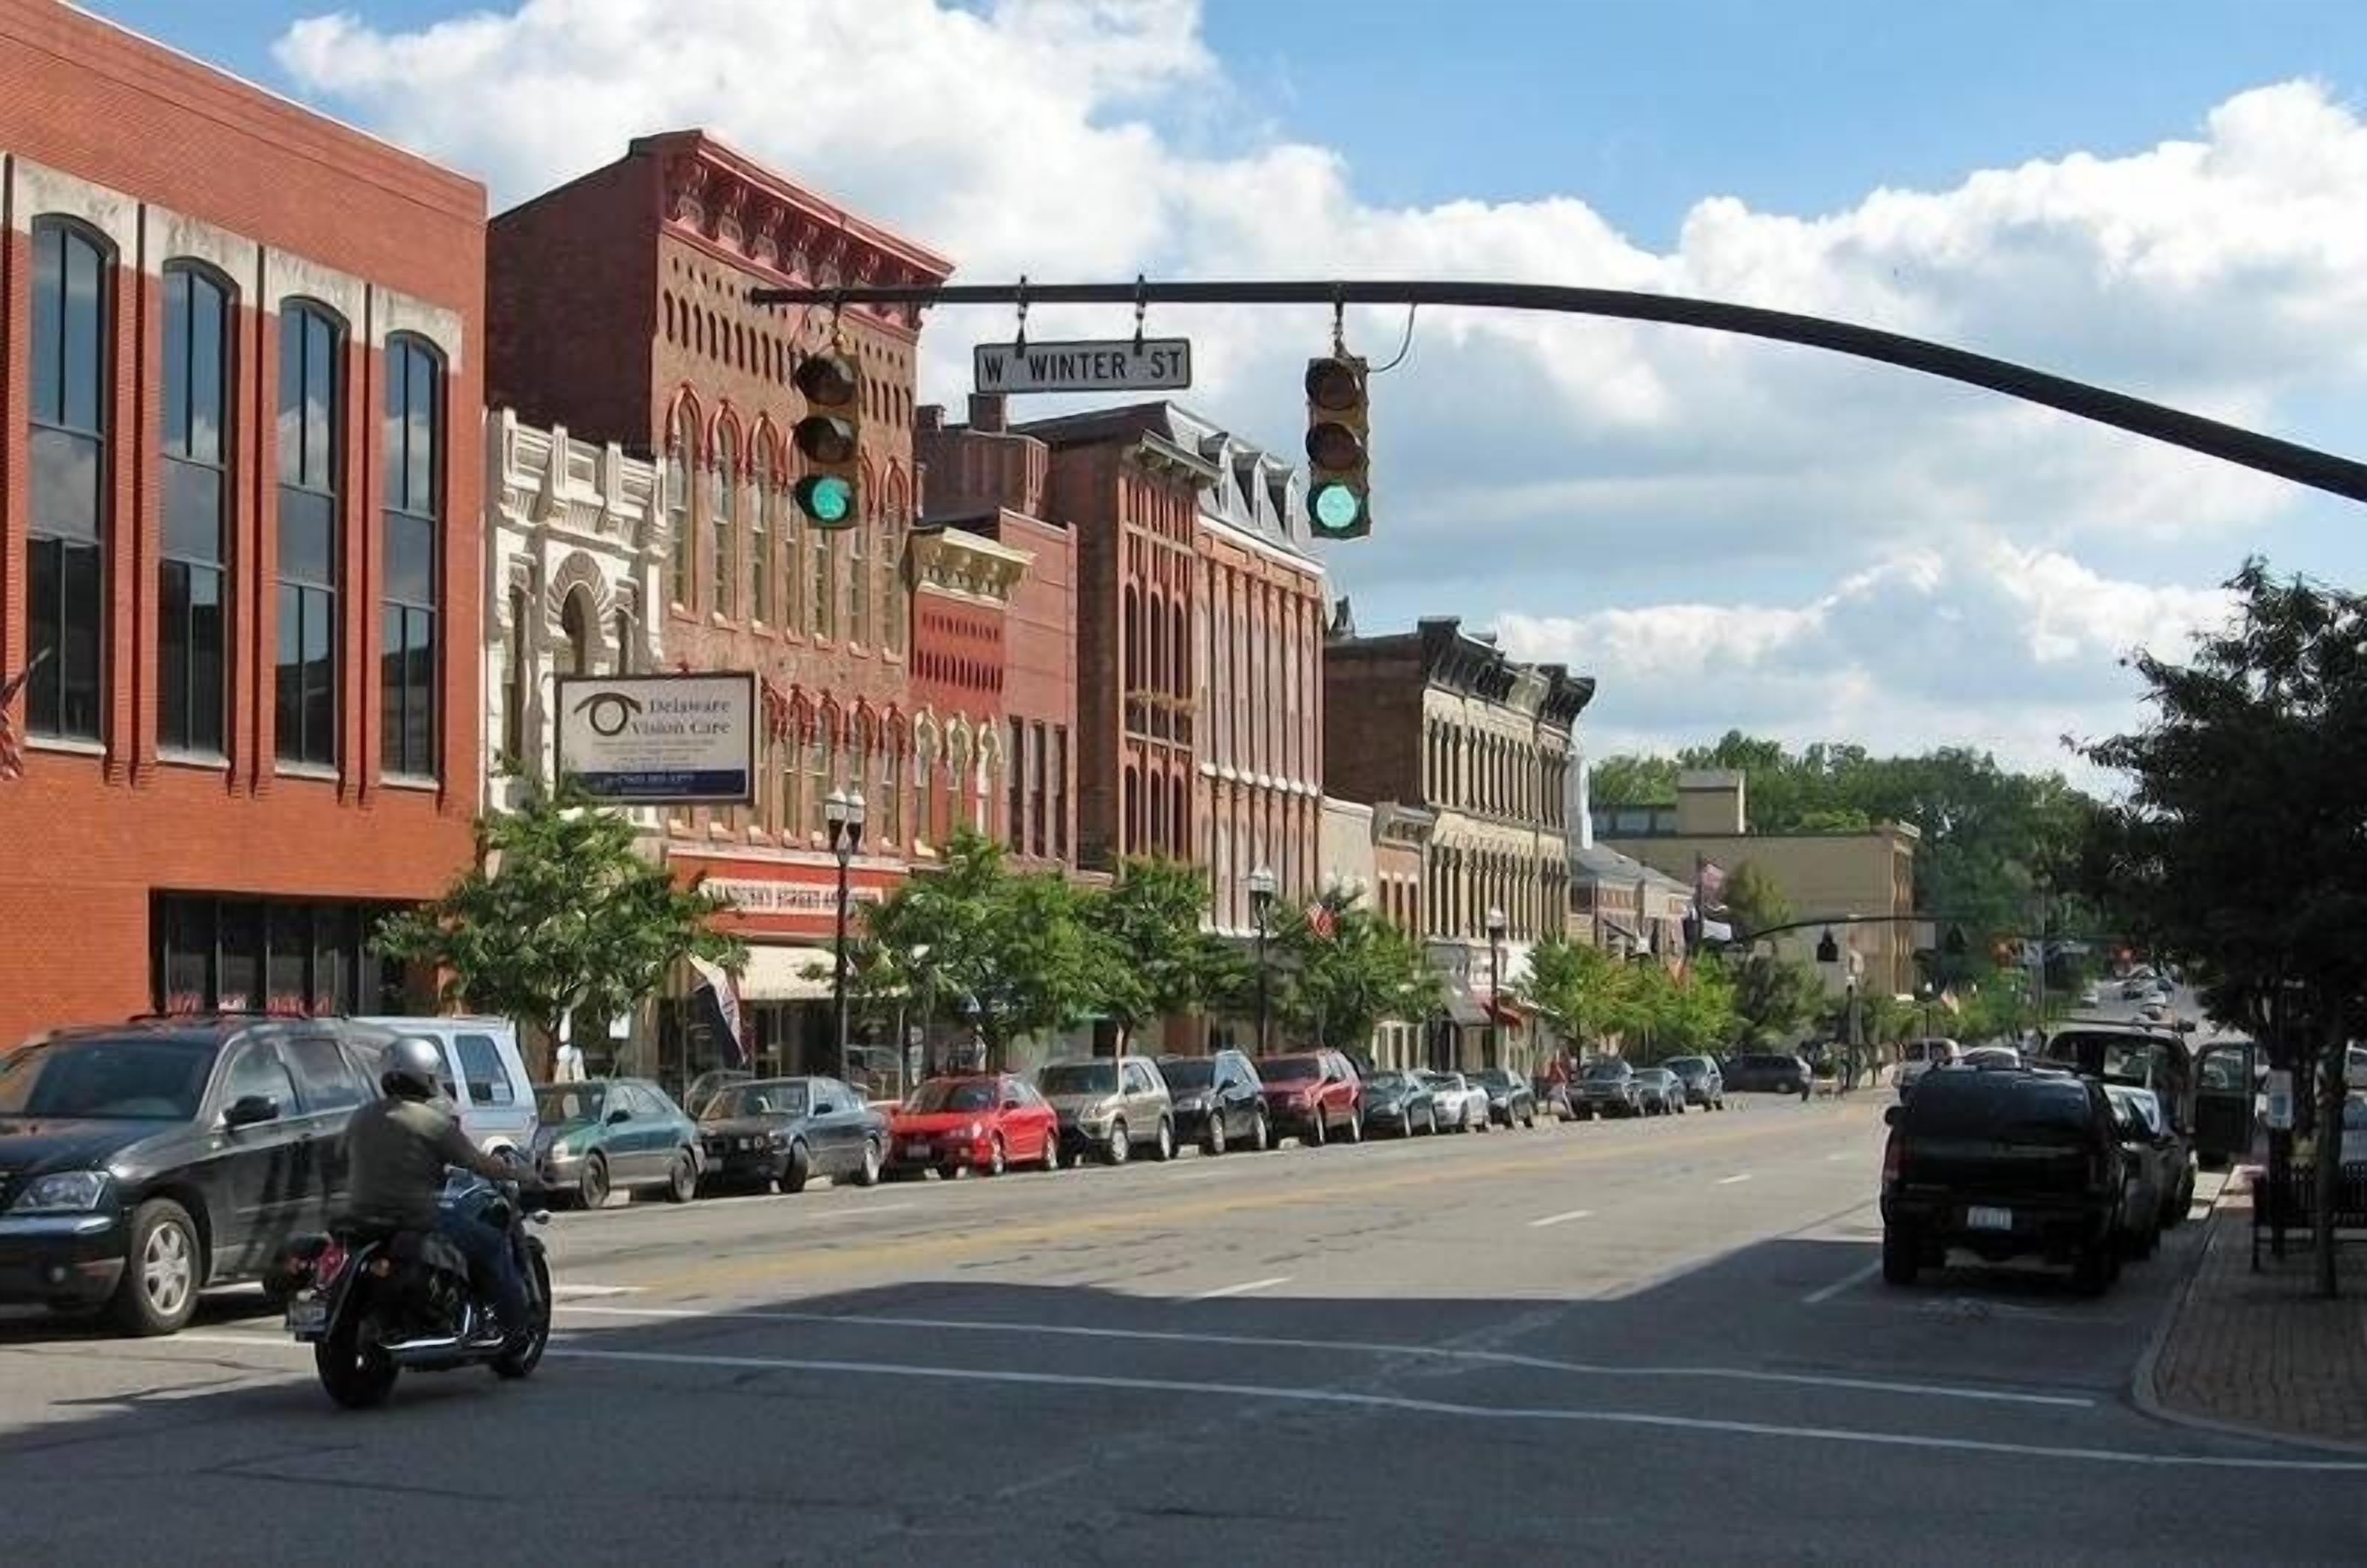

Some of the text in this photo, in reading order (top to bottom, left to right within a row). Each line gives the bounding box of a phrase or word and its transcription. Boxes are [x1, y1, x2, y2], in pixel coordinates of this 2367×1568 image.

[982, 349, 1182, 382] W WINTER ST
[649, 697, 732, 714] Delaware
